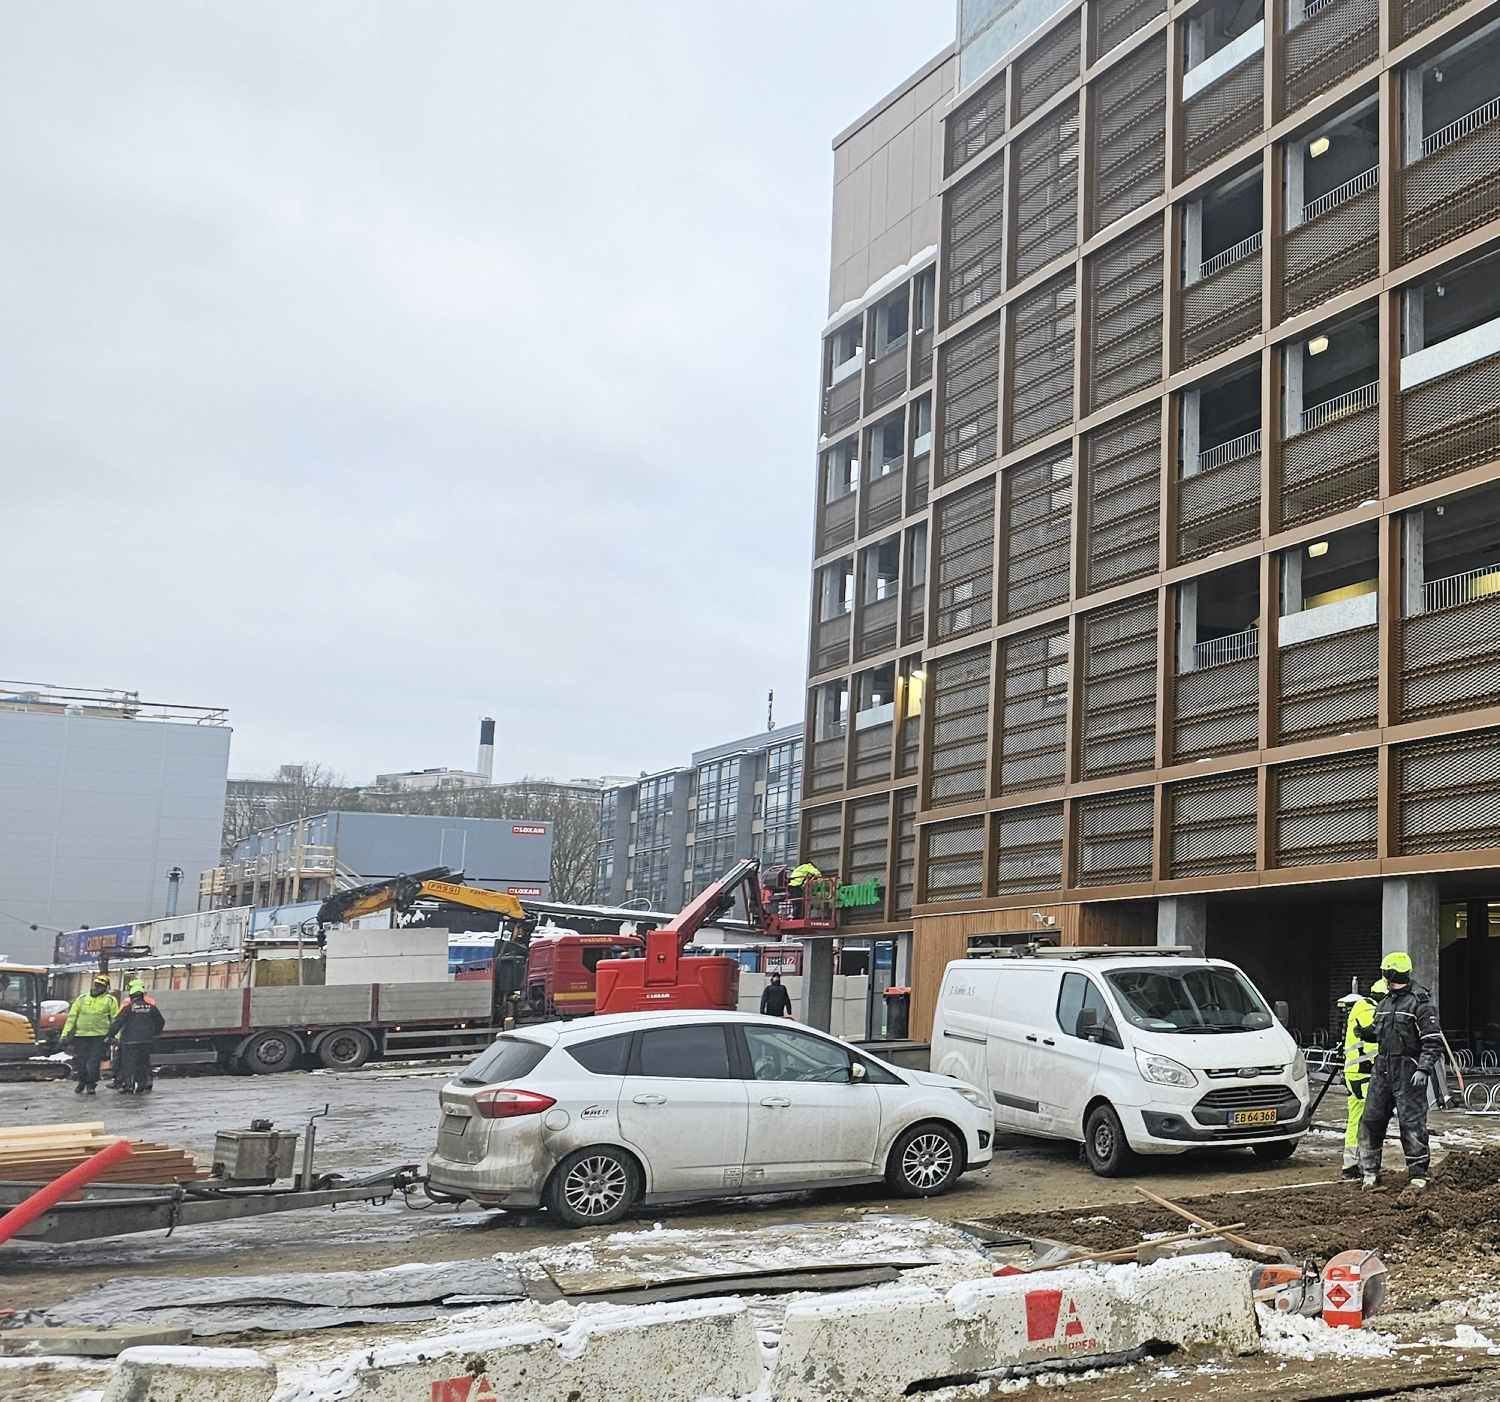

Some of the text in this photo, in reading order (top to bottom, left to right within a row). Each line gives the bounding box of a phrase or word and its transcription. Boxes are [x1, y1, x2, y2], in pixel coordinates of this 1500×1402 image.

[1235, 1111, 1276, 1123] EB 64 368
